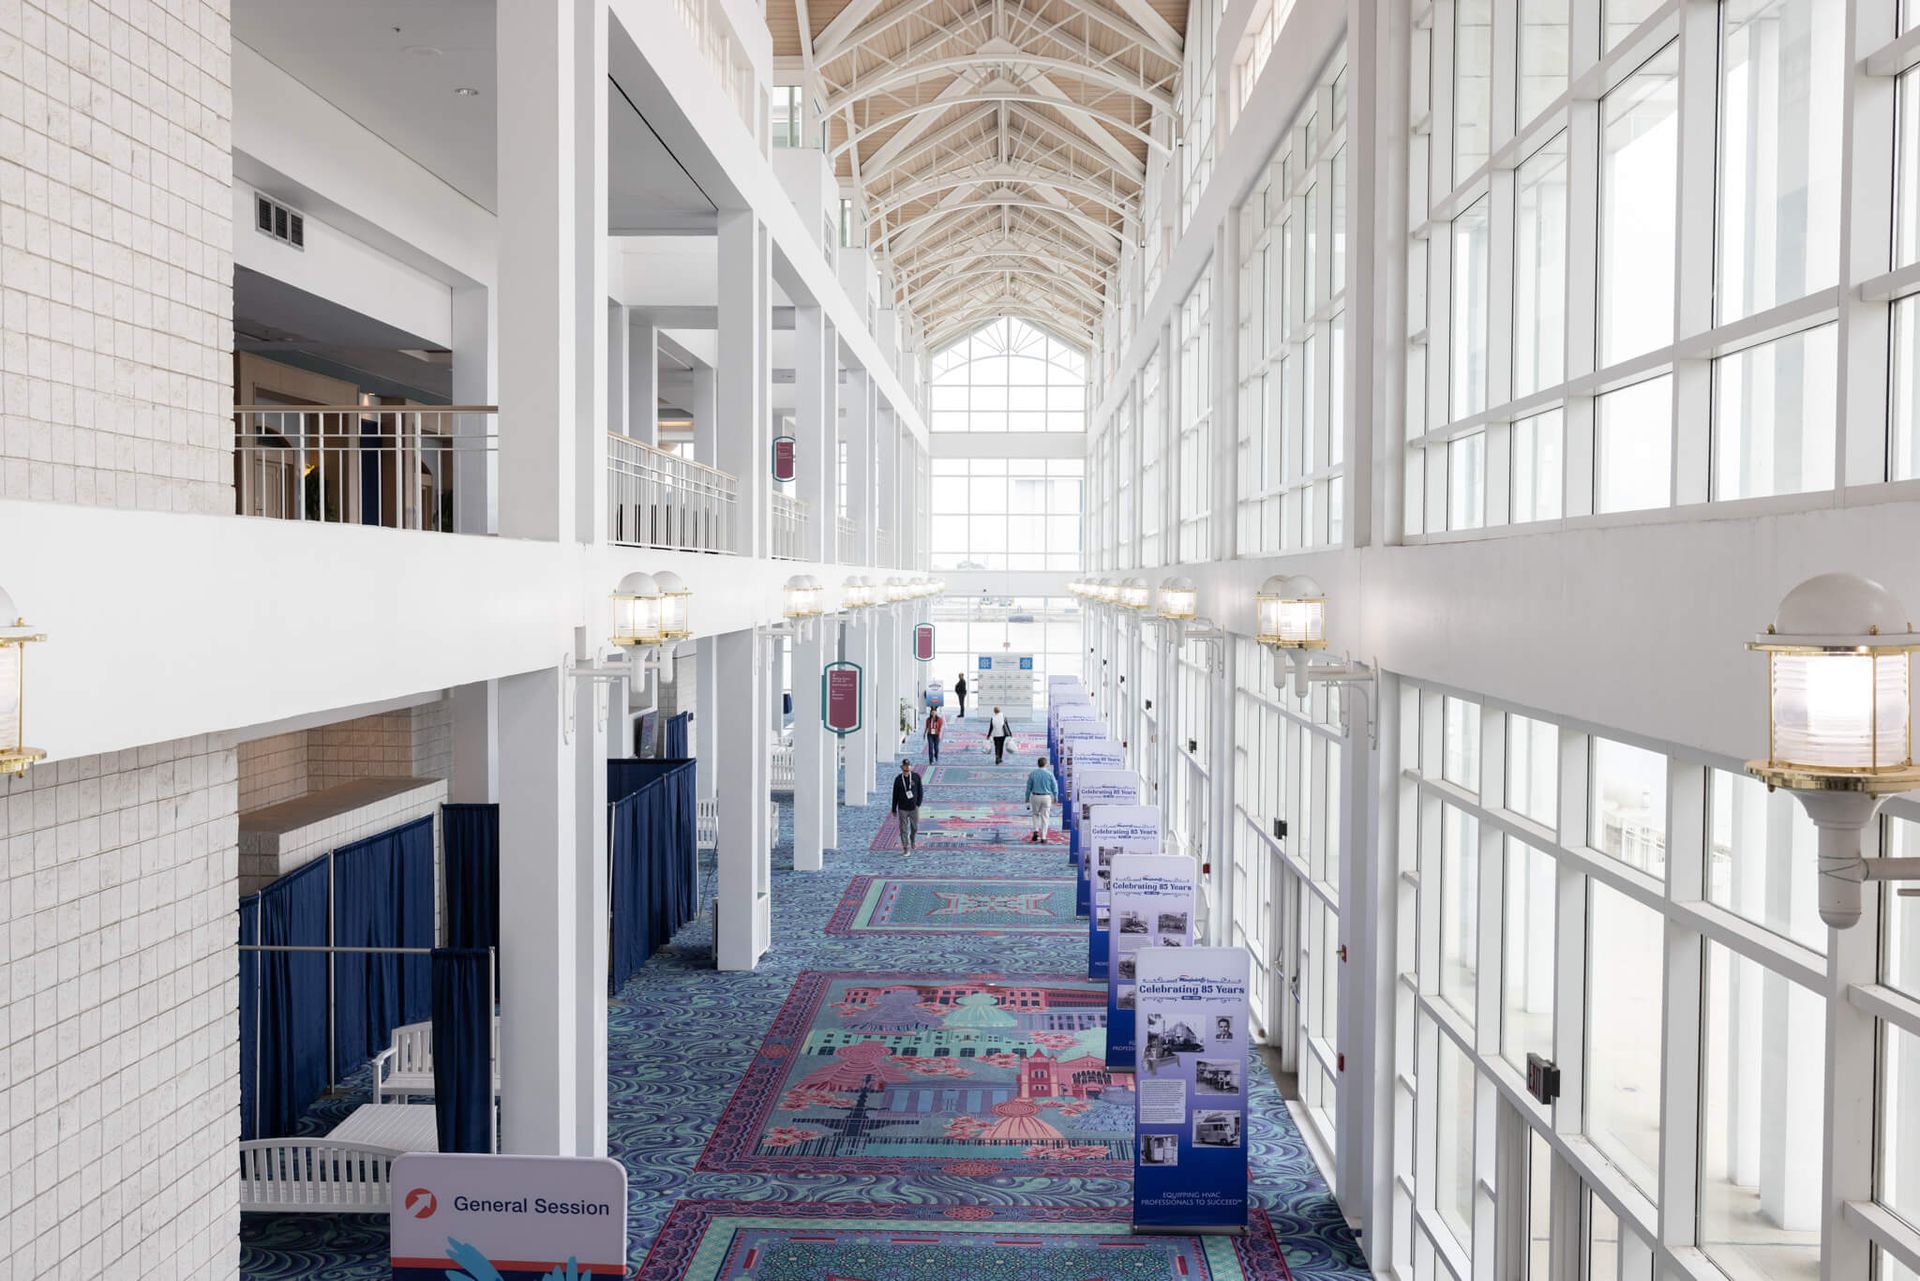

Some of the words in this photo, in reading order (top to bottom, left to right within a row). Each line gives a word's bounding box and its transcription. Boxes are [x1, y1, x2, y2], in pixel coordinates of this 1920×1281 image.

[1112, 882, 1157, 891] Celebrating
[1170, 883, 1192, 891] Years
[1139, 984, 1199, 995] Celebrating
[1201, 985, 1213, 993] 85
[1216, 985, 1245, 994] Years
[1162, 1191, 1200, 1199] EQUIPPING
[454, 1195, 528, 1214] General
[534, 1197, 610, 1216] Session
